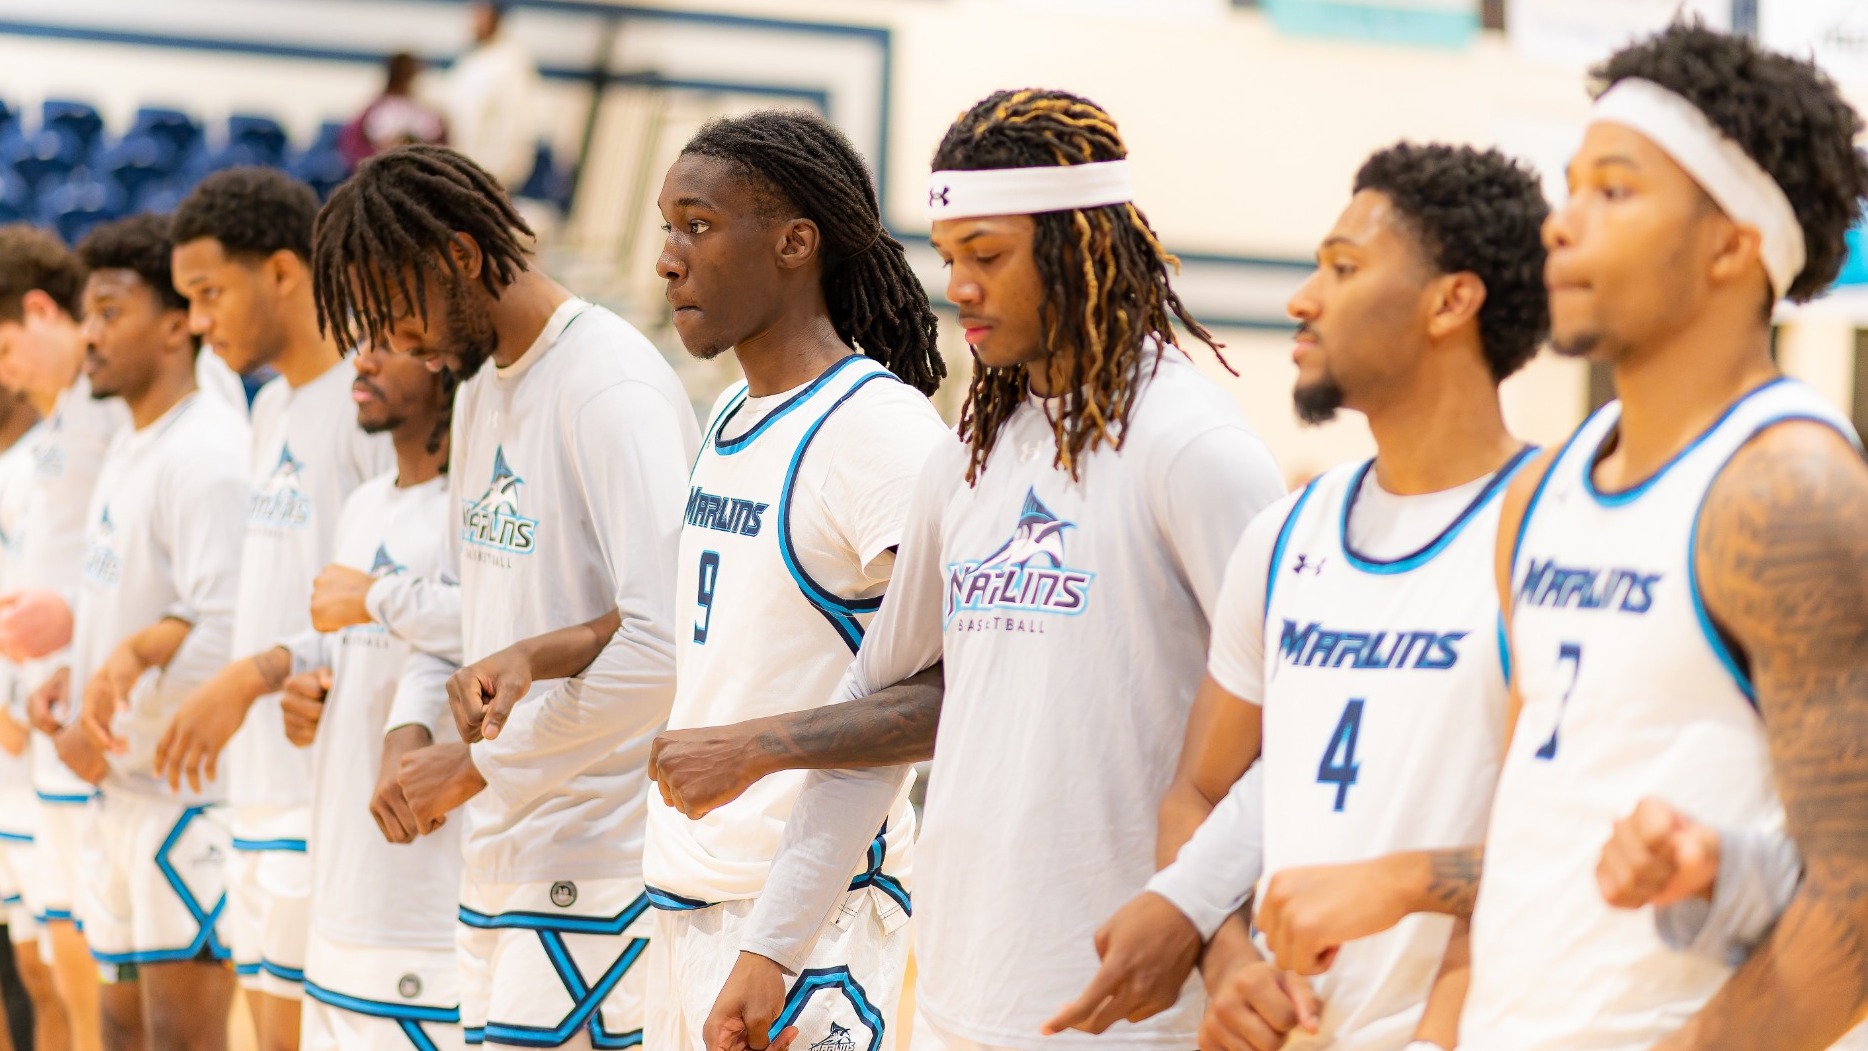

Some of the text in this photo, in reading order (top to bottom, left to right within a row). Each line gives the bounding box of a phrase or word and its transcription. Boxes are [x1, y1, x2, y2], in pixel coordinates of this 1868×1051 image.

[683, 484, 770, 537] MARLINS
[693, 549, 720, 645] 9
[1276, 618, 1473, 672] MARLINS
[1315, 698, 1365, 812] 4
